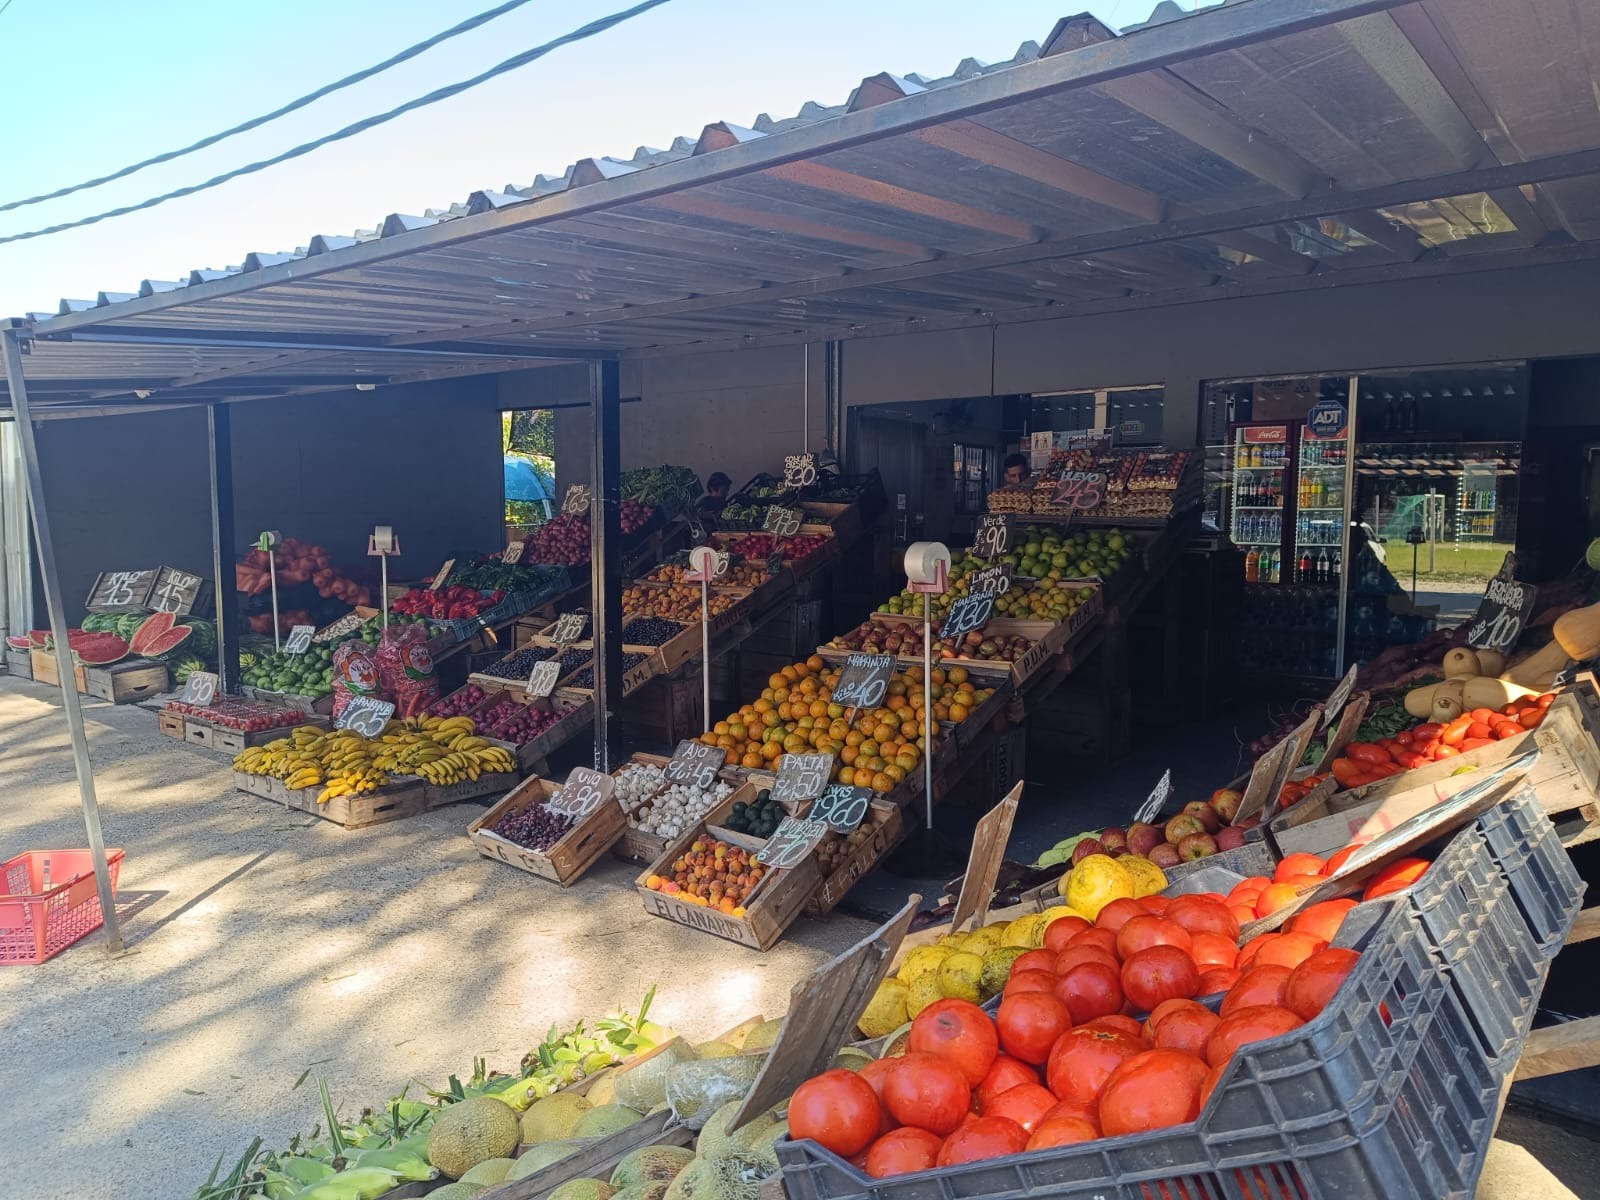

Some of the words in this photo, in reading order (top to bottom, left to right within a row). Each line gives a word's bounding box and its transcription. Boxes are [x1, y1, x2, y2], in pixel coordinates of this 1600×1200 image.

[1313, 410, 1341, 424] ADT
[1061, 471, 1099, 482] HUEVO
[569, 492, 591, 513] 65
[1051, 480, 1101, 509] 245
[972, 566, 1002, 584] LIMON
[101, 580, 133, 606] 15
[154, 585, 183, 612] 15
[950, 599, 992, 636] 130
[1477, 607, 1520, 649] 100
[289, 631, 310, 653] 40
[189, 678, 212, 703] 90
[851, 667, 886, 706] 40
[350, 695, 392, 717] BANANA
[347, 708, 386, 737] 65
[693, 761, 718, 789] 45
[783, 754, 825, 771] PALTA
[567, 786, 601, 815] 80
[769, 833, 809, 866] 70
[654, 898, 674, 921] EL
